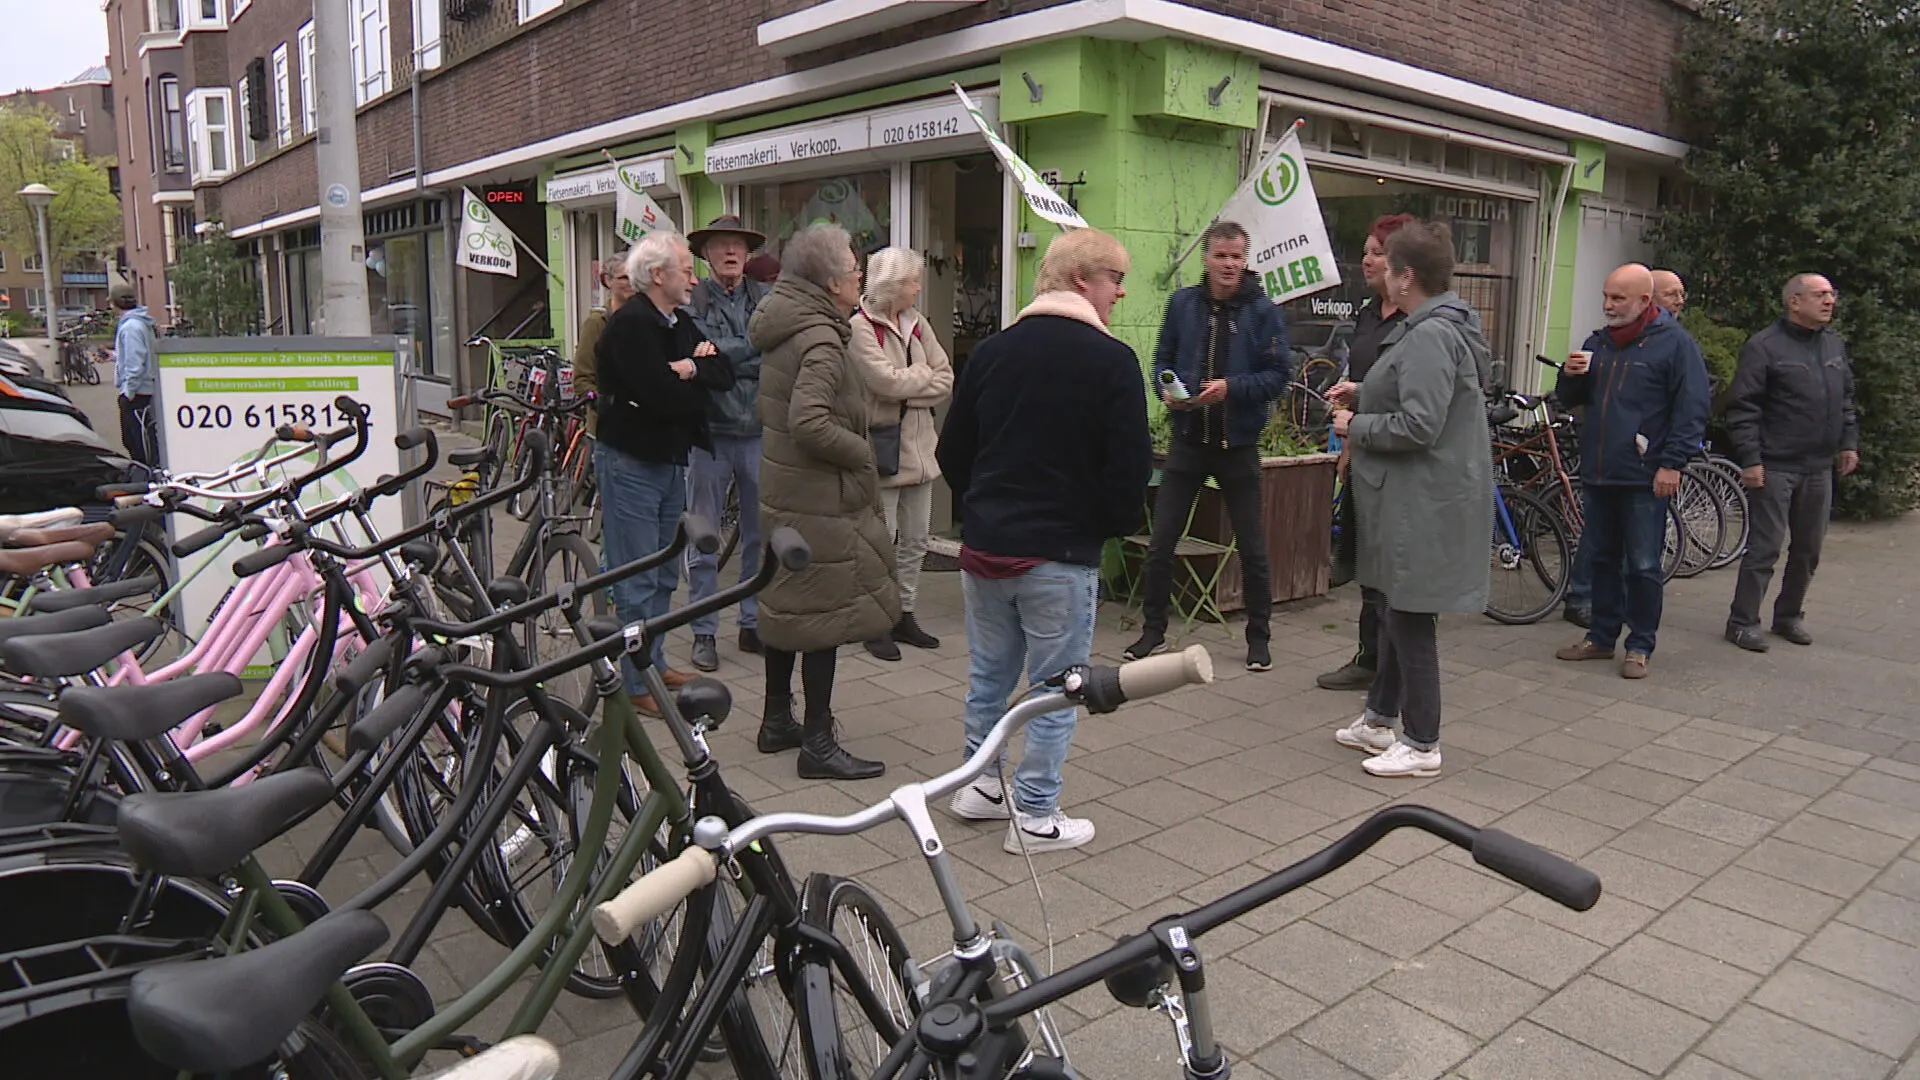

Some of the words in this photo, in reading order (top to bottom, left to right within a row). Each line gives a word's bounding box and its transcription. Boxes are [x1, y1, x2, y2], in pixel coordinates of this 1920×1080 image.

[707, 146, 781, 172] Fietsenmakerij.
[790, 137, 841, 157] Verkoop.
[883, 127, 904, 145] 020
[907, 117, 959, 141] 6158142
[487, 191, 523, 203] OPEN
[469, 252, 512, 269] VERKOOP
[1264, 255, 1324, 298] ALER
[306, 378, 350, 389] stalling
[177, 405, 232, 428] 020
